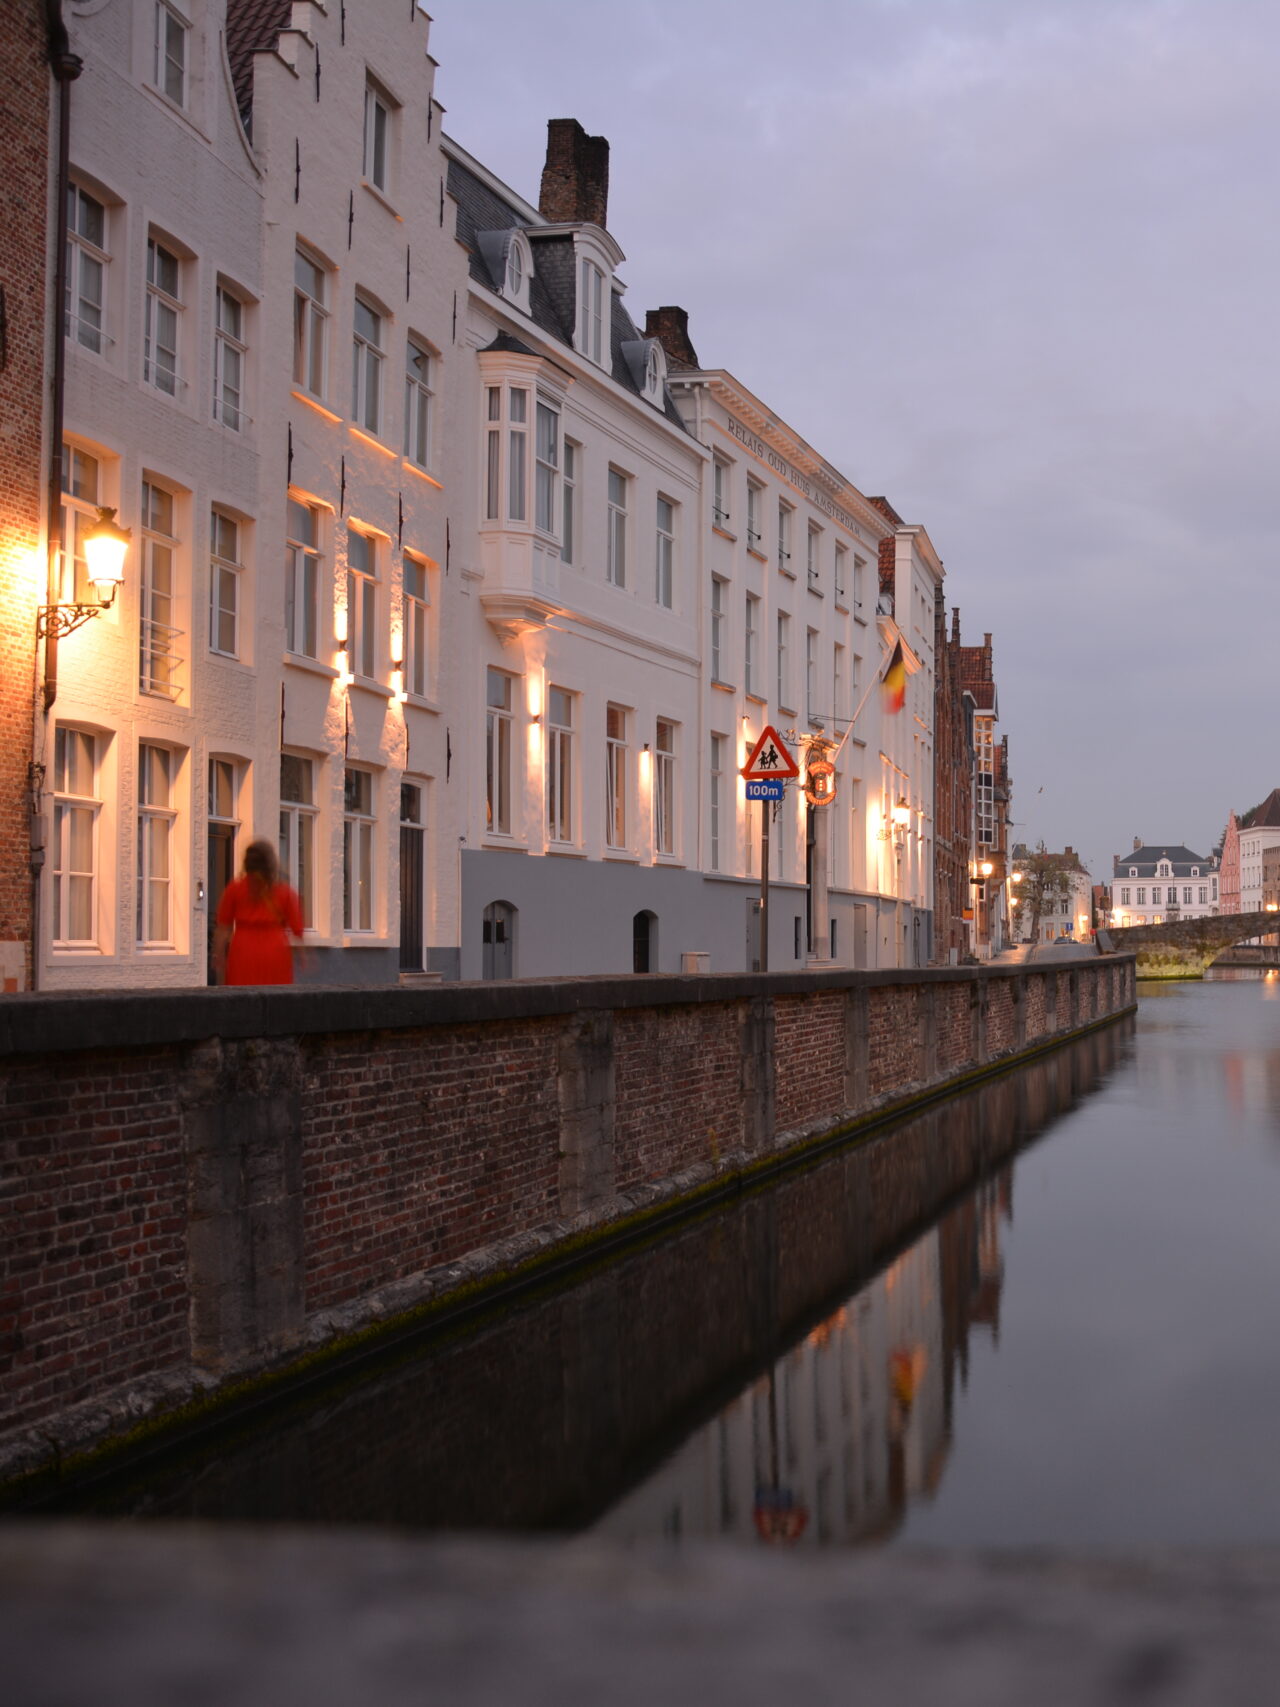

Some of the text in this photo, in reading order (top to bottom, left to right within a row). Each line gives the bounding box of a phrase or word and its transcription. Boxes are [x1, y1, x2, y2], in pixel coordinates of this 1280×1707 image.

[728, 417, 861, 537] RELAIS OUD HUIS AMSTERDAM
[749, 785, 778, 796] 100m
